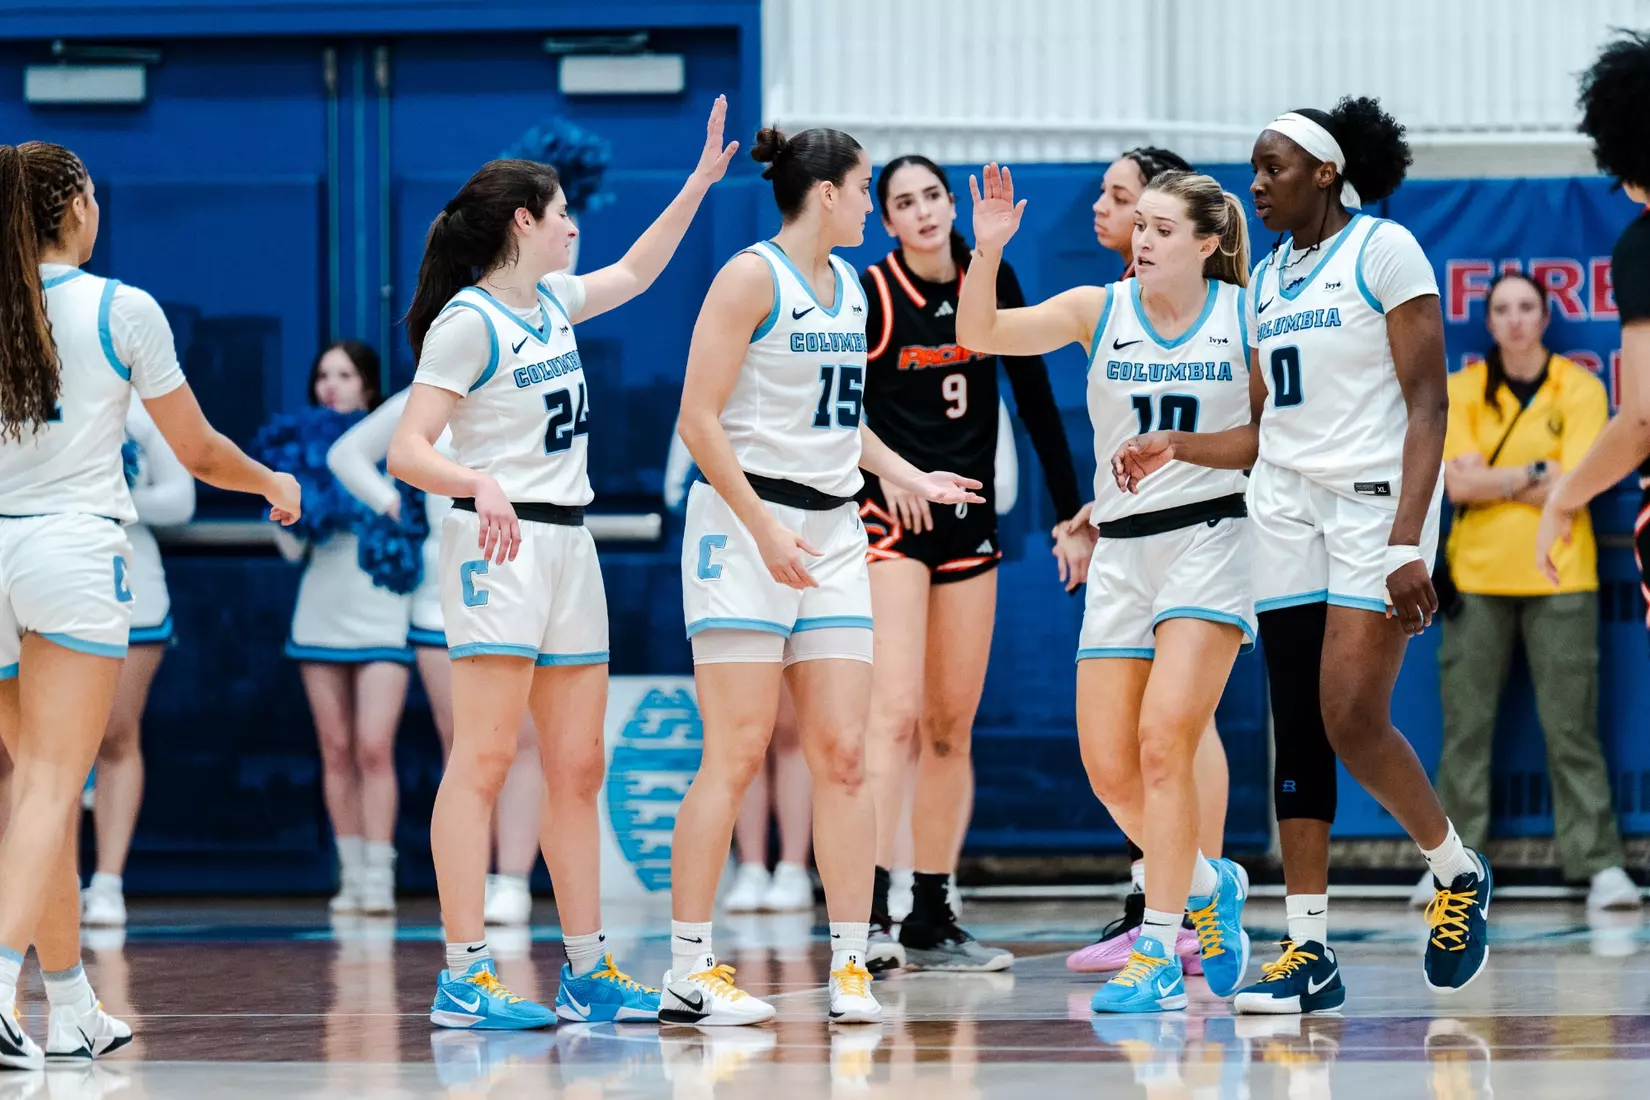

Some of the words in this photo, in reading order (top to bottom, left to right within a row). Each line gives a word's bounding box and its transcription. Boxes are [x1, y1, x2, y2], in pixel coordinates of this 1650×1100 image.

[1445, 257, 1620, 322] FRE
[790, 332, 867, 352] COLUMB
[1257, 307, 1342, 342] OLUMBIA
[513, 350, 582, 388] COLUMB
[1106, 360, 1233, 382] COLUMBIA
[1270, 344, 1304, 409] 0
[542, 382, 589, 456] 24
[811, 364, 863, 430] 15
[942, 373, 968, 419] 9
[1131, 393, 1200, 434] 10
[697, 534, 728, 580] C
[460, 559, 489, 608] C
